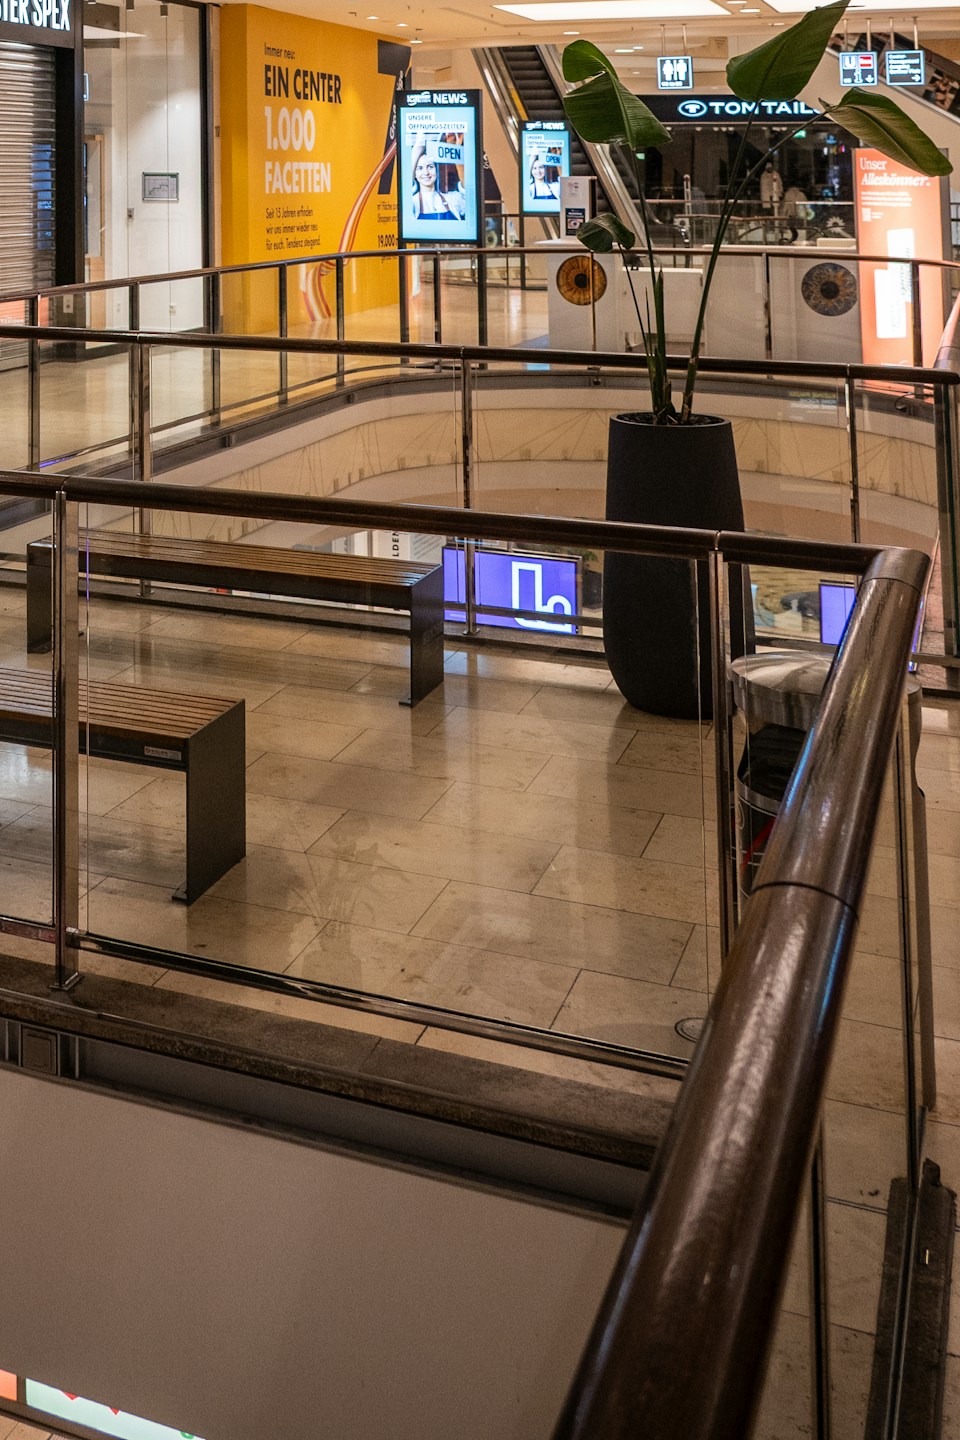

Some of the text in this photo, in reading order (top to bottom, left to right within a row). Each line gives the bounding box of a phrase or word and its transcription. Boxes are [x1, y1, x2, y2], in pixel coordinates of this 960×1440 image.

[264, 42, 283, 57] Immer
[264, 64, 342, 104] EIN CENTER
[433, 93, 468, 104] NEWS
[709, 101, 823, 115] TOM TAIL
[264, 106, 316, 152] 1.000
[438, 147, 460, 160] OPEN
[546, 155, 560, 164] OPEN
[860, 158, 887, 170] Unser
[265, 161, 331, 194] FACETTEN
[861, 172, 931, 187] Alleskönner.
[265, 205, 313, 219] Seit 15 Jahren erfinden
[282, 223, 295, 233] immer
[296, 221, 310, 232] wieder
[286, 237, 303, 248] Tendenz
[377, 234, 394, 248] 19.000
